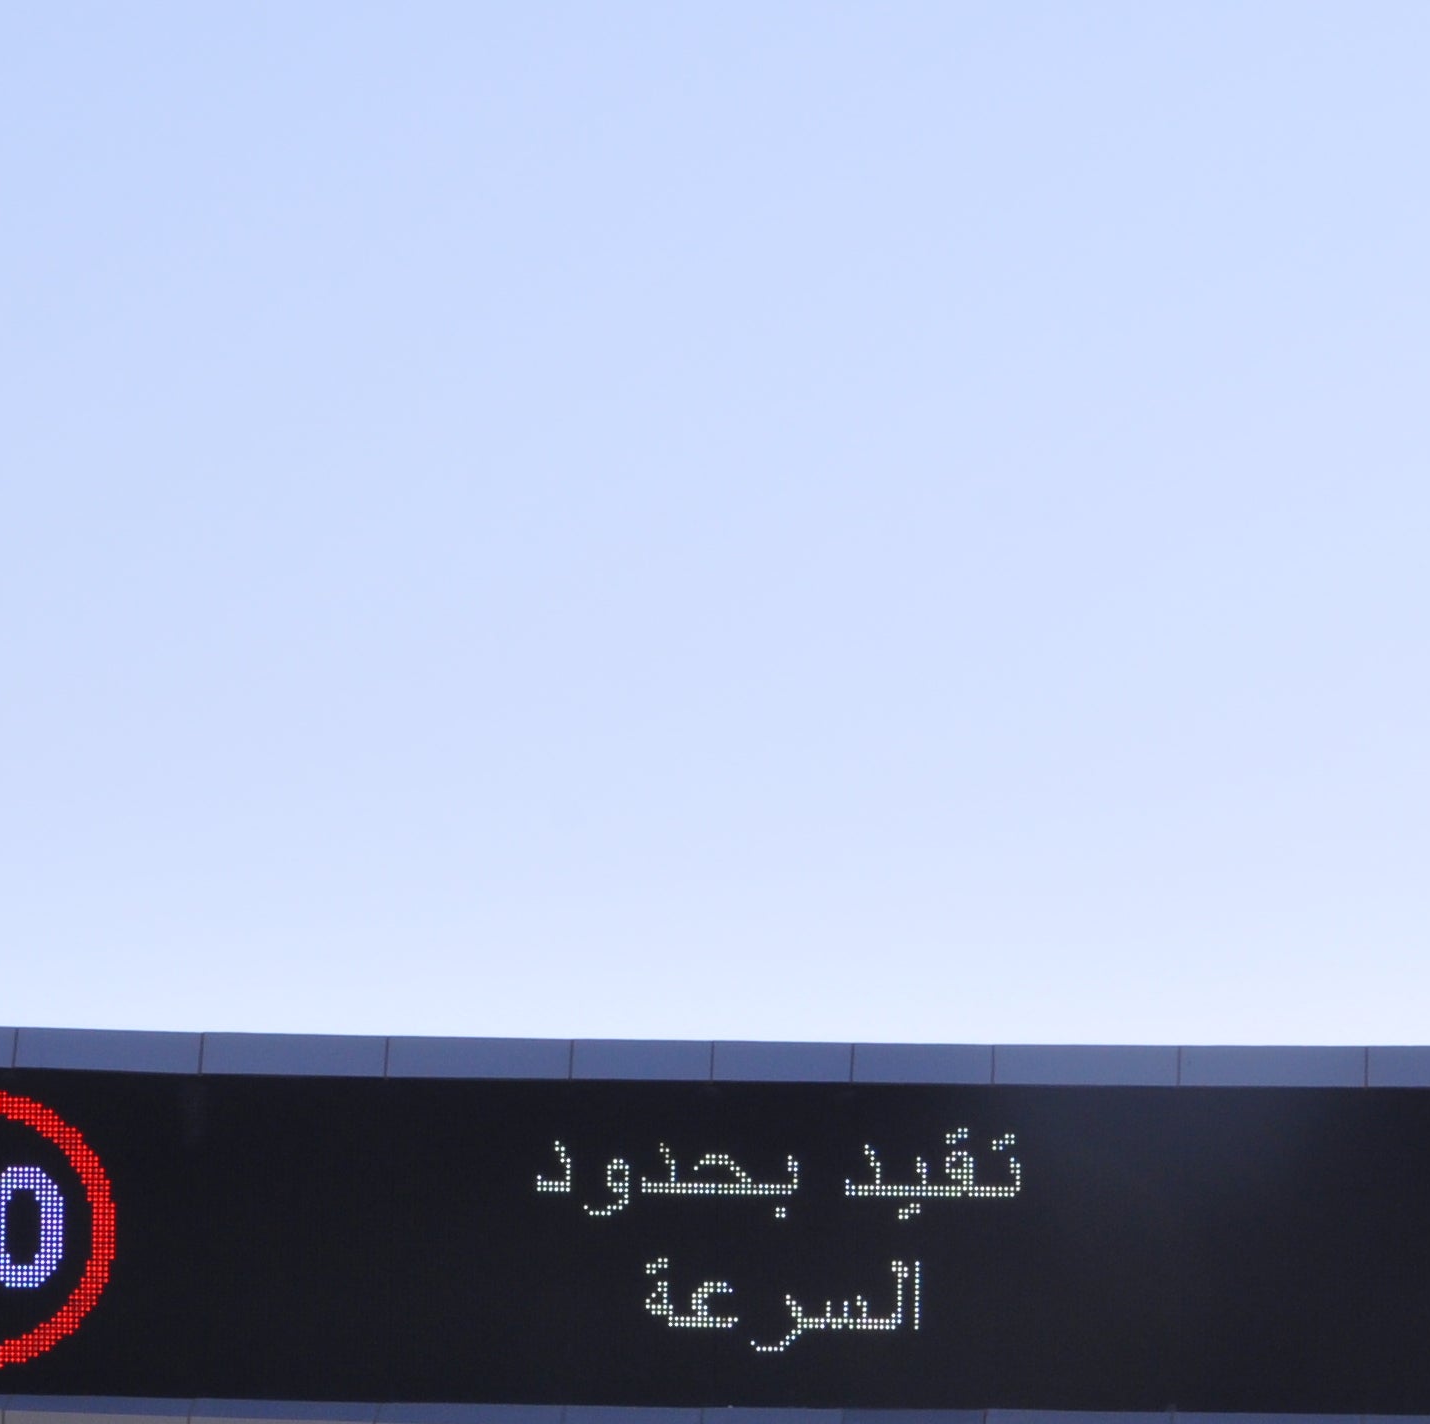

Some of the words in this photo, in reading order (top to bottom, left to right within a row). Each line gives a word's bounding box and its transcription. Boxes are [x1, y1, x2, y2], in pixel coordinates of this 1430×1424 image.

[535, 1139, 799, 1219] بحدود
[843, 1126, 1021, 1220] تقيد
[644, 1256, 921, 1353] السرعة
